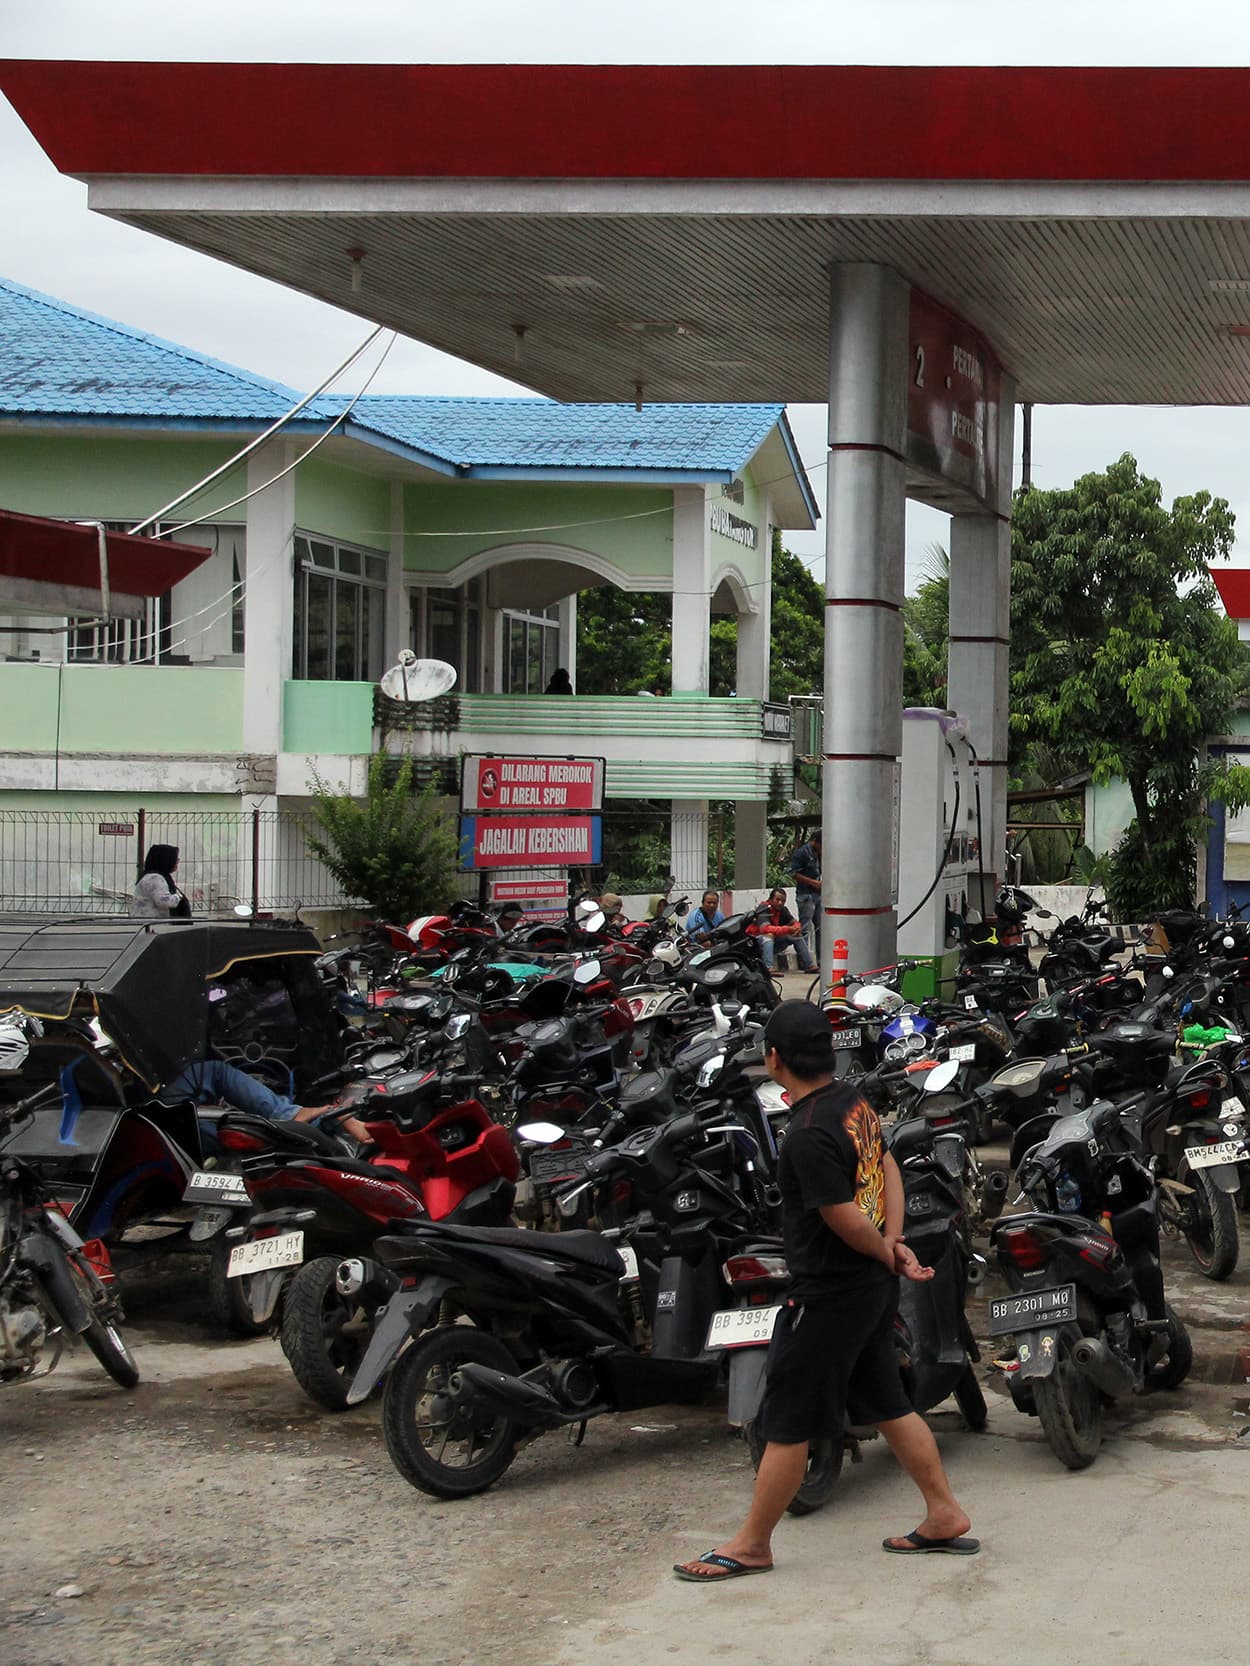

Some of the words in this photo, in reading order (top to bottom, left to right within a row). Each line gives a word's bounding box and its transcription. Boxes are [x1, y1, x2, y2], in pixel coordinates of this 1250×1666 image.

[916, 345, 925, 388] 2
[501, 763, 546, 782] DILARANG
[548, 765, 592, 783] MEROKOK
[500, 787, 510, 804] DI
[512, 787, 541, 804] AREAL
[543, 788, 567, 805] SPBU
[480, 829, 526, 855] JAGALAH
[528, 828, 588, 853] KEBERSIHAN
[341, 1173, 381, 1186] VARIO
[232, 1247, 245, 1262] BB
[252, 1240, 279, 1257] 3721
[286, 1235, 301, 1249] HY
[992, 1303, 1008, 1319] BB
[1014, 1296, 1043, 1314] 2301
[714, 1314, 731, 1329] BB
[737, 1309, 771, 1326] 3994
